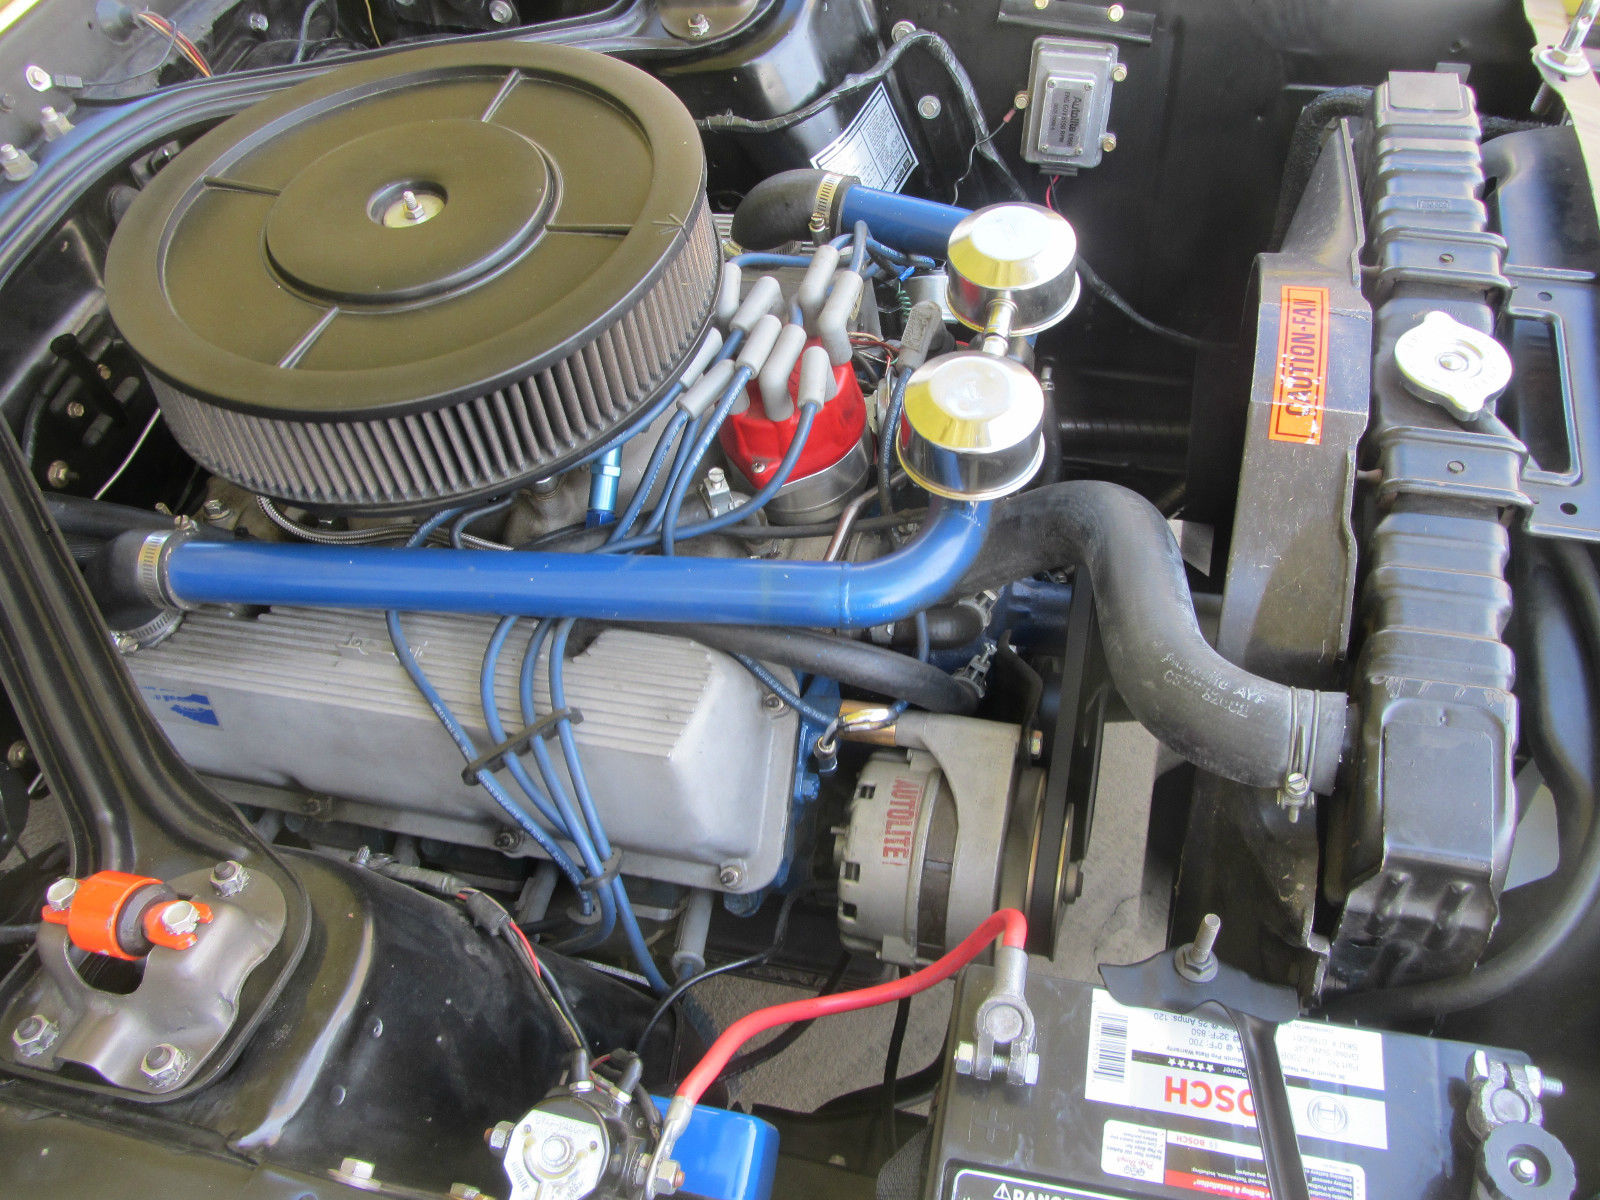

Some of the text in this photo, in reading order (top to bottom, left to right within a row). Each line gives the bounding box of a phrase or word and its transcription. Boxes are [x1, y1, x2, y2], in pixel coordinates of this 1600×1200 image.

[1069, 96, 1081, 132] Autolite
[882, 777, 922, 858] AUTOLITE
[1153, 1012, 1168, 1021] 120
[1191, 1028, 1205, 1037] 850
[1188, 1038, 1203, 1046] 700
[1166, 1045, 1194, 1055] Warranty
[1222, 1066, 1246, 1077] Power
[1164, 1076, 1255, 1116] OSCH
[1175, 1134, 1205, 1146] BOSCH
